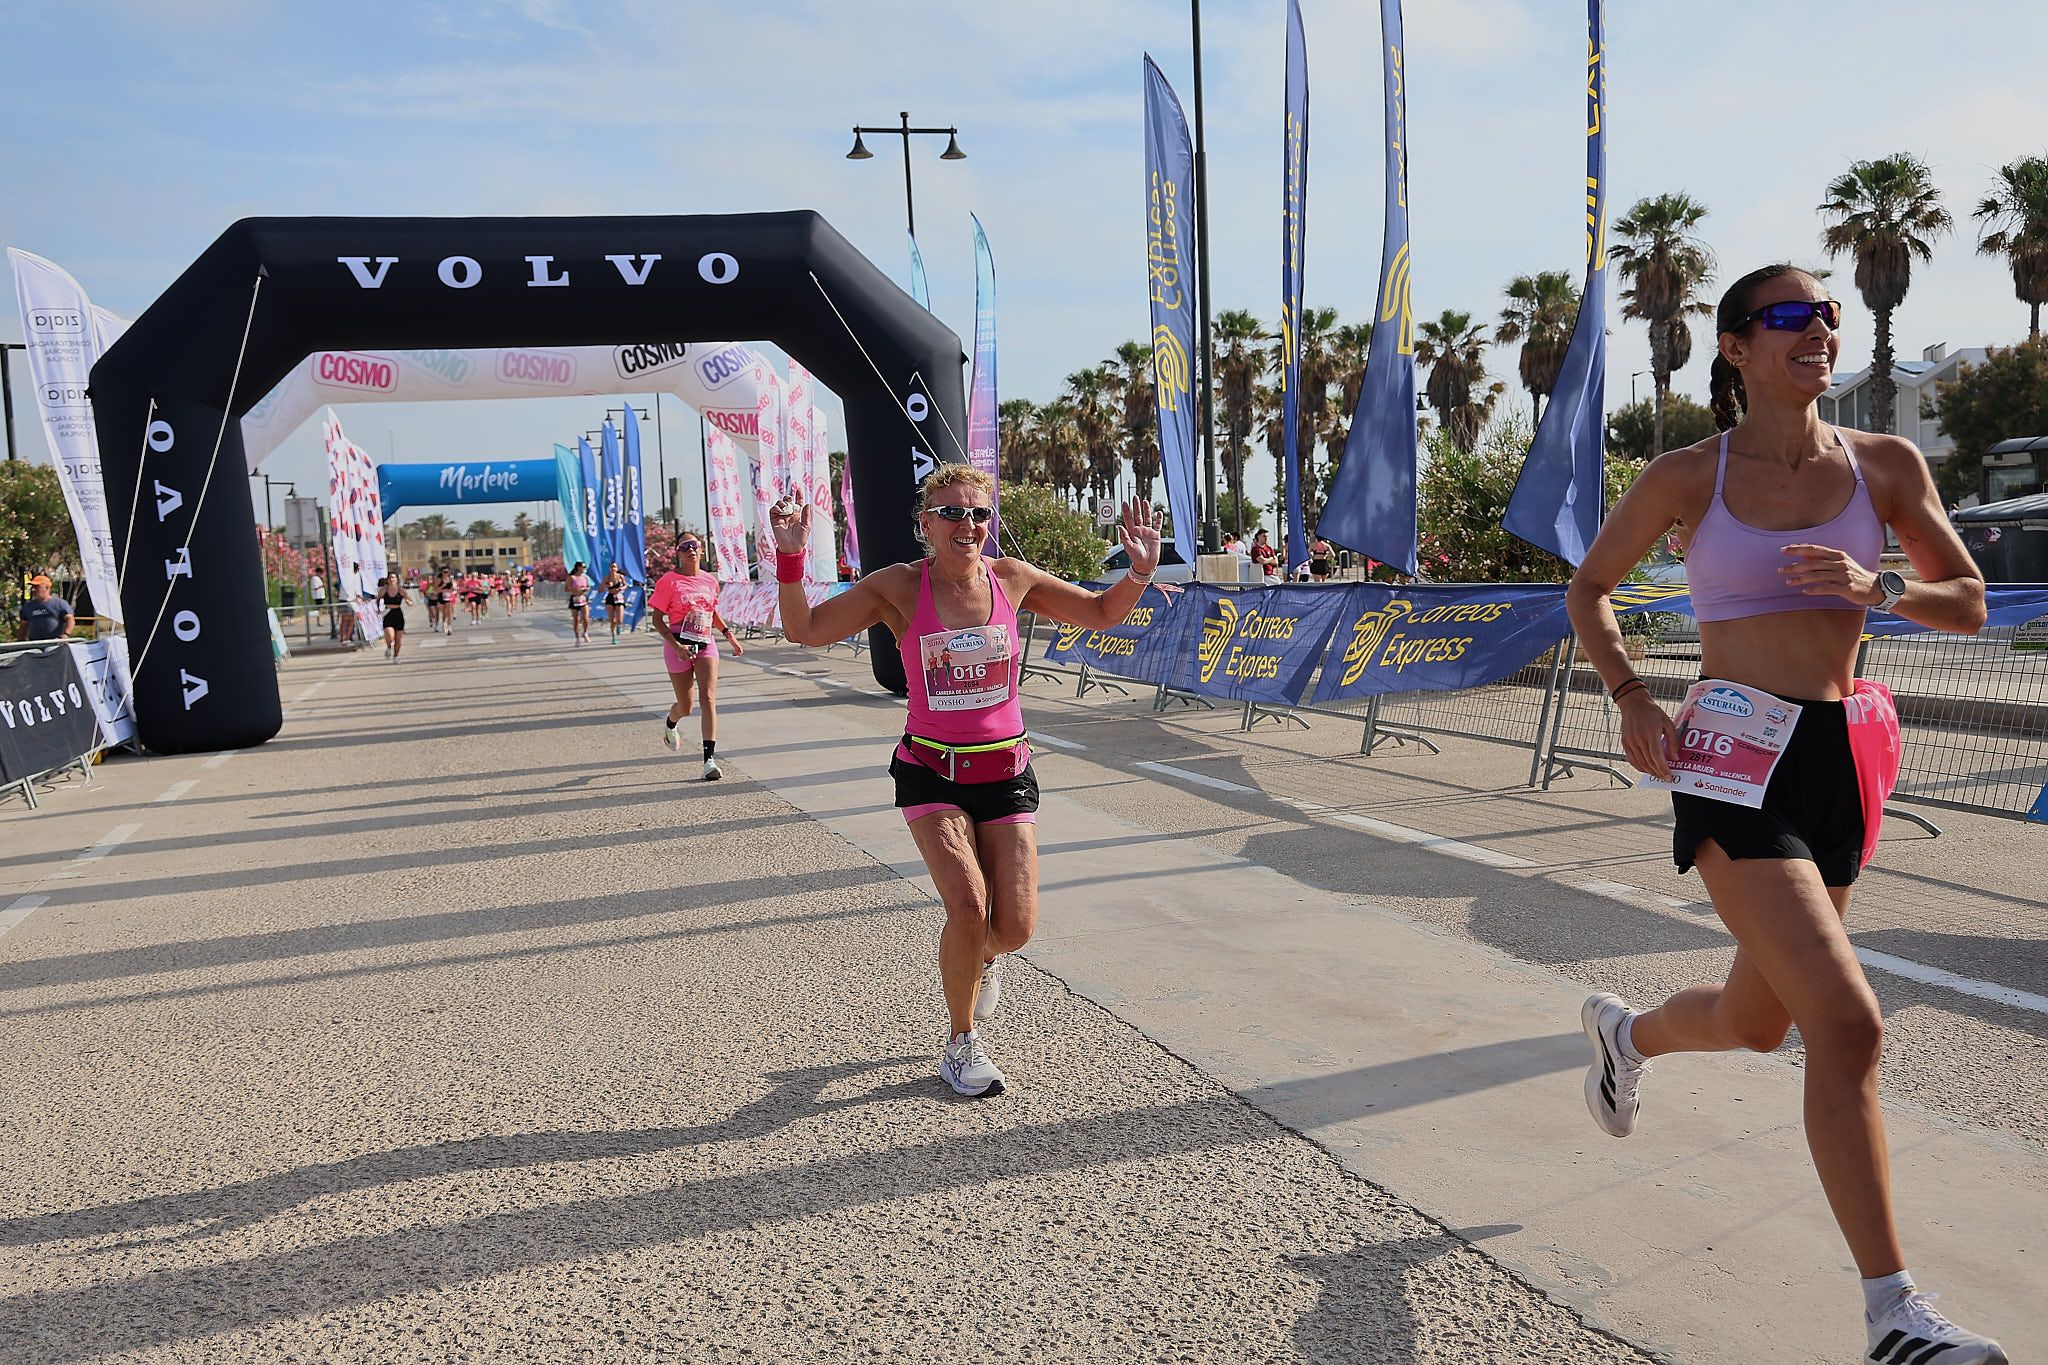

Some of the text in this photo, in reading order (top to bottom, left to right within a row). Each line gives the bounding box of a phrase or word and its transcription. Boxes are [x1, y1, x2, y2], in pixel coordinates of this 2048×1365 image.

[336, 251, 741, 289] VOLVO
[319, 352, 392, 389] COSMO
[501, 351, 571, 384] COSMO
[621, 343, 686, 374] COSMO
[702, 344, 755, 385] COSM
[439, 464, 519, 499] Marlene
[148, 420, 210, 711] VOLVO
[1239, 609, 1298, 640] Correos
[1086, 630, 1139, 659] Express
[1379, 633, 1473, 674] Express
[953, 663, 987, 681] 016
[1225, 646, 1284, 685] Express
[937, 698, 965, 707] OYSHO
[1684, 729, 1734, 756] 016
[1689, 752, 1713, 764] 2817
[1692, 764, 1715, 774] MUJER
[1720, 770, 1752, 782] VALENCIA
[1704, 782, 1748, 797] Santander
